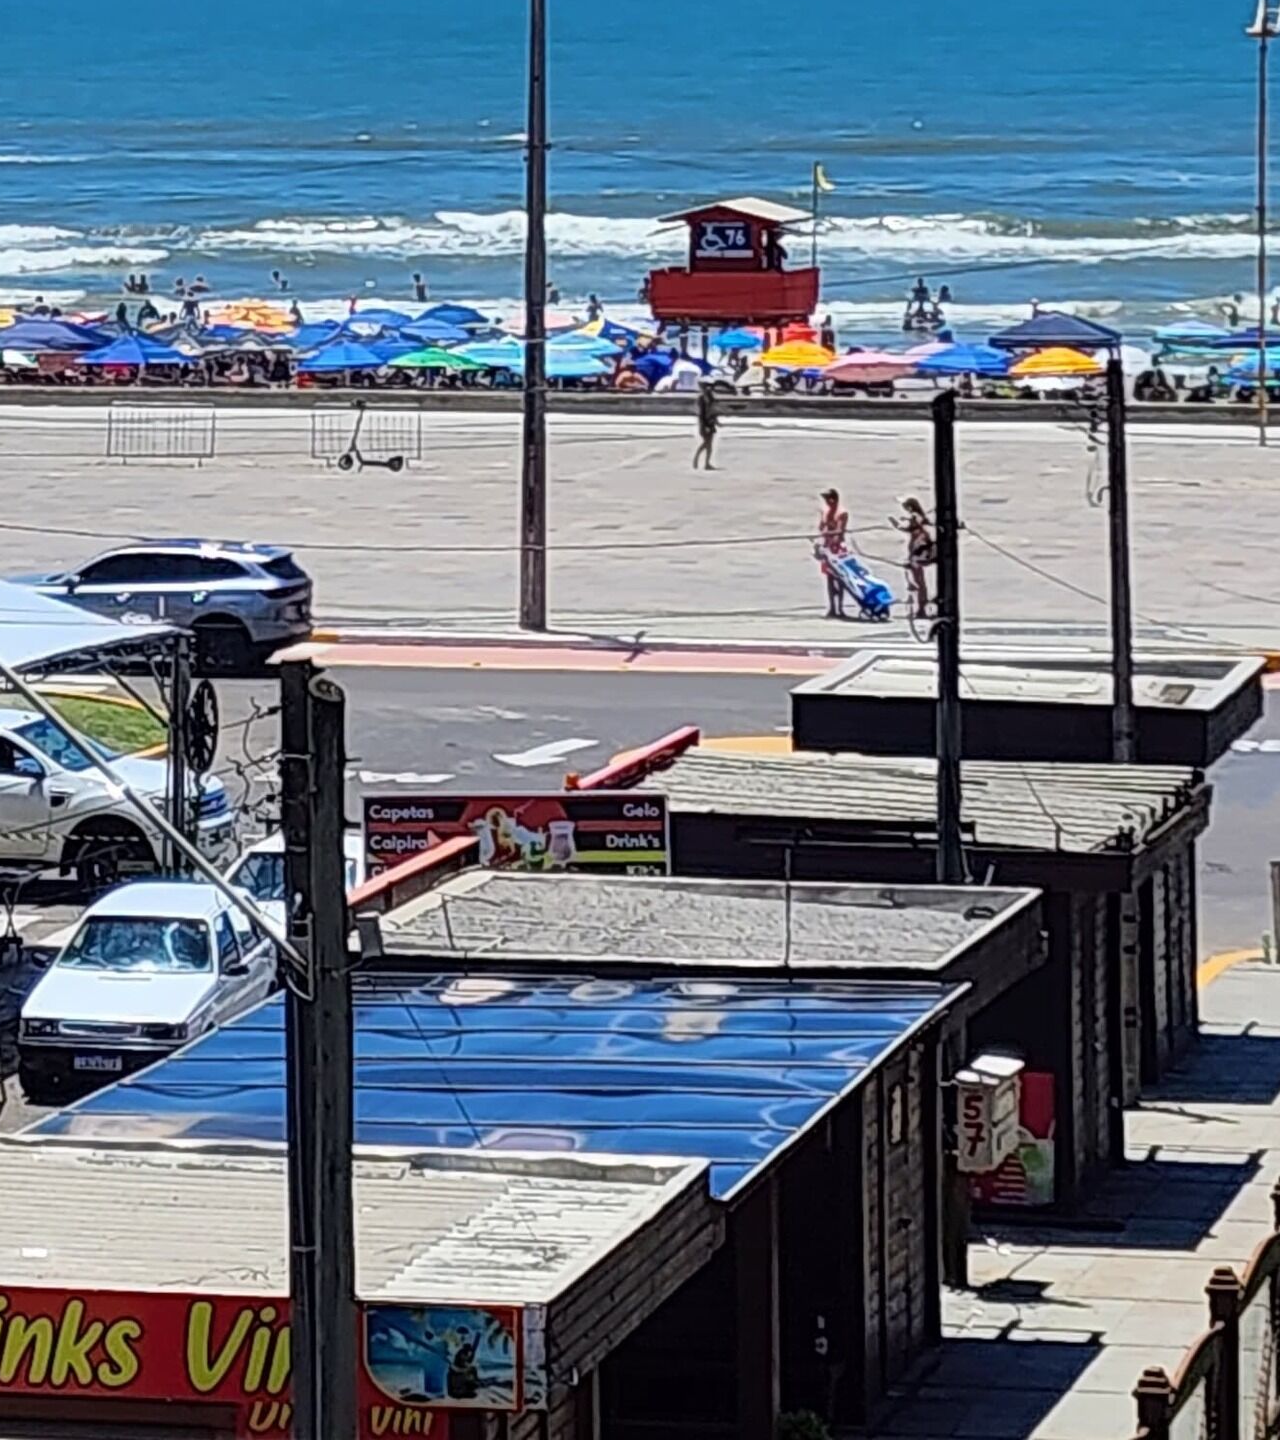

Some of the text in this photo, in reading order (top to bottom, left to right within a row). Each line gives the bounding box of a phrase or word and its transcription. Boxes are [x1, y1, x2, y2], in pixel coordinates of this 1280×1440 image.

[724, 229, 746, 246] 76
[369, 804, 434, 823] Capetas
[623, 802, 660, 817] Gelo
[606, 834, 660, 848] Drink's
[963, 1095, 987, 1157] 57
